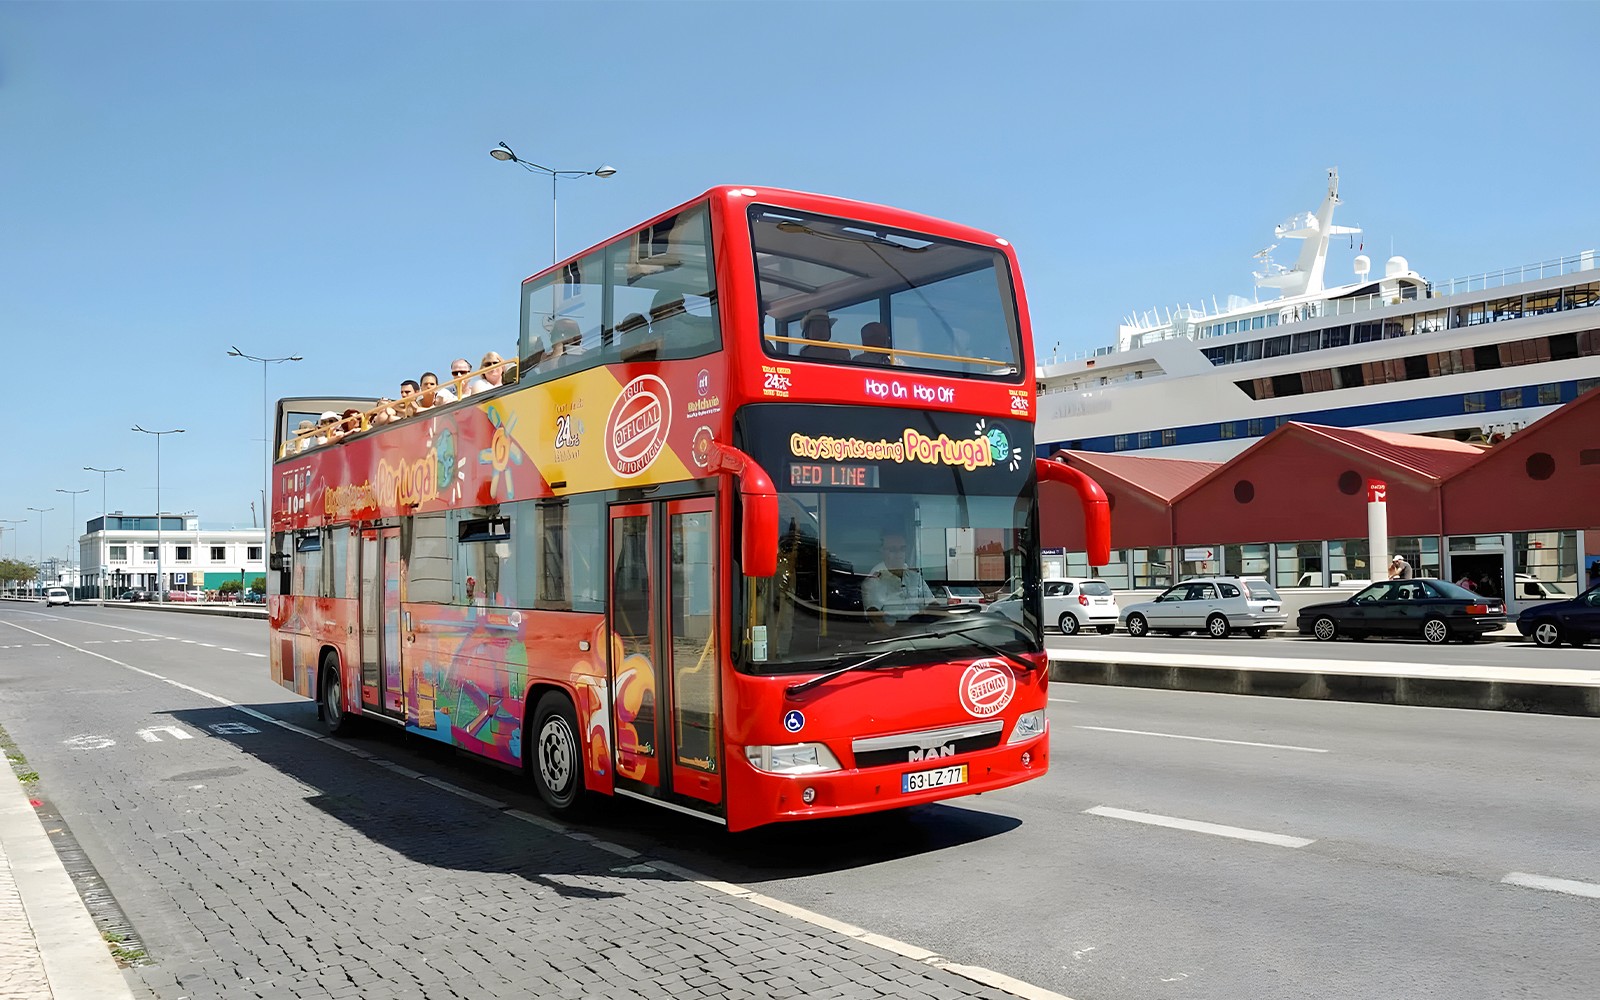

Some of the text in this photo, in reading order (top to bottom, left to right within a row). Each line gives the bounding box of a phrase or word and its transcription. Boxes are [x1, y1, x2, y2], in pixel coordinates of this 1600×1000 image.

[865, 379, 955, 403] Hop On Hop Off
[615, 407, 660, 447] OFFICIAL
[903, 428, 993, 471] Portugal
[791, 465, 866, 486] RED LINE
[908, 744, 956, 762] MAN
